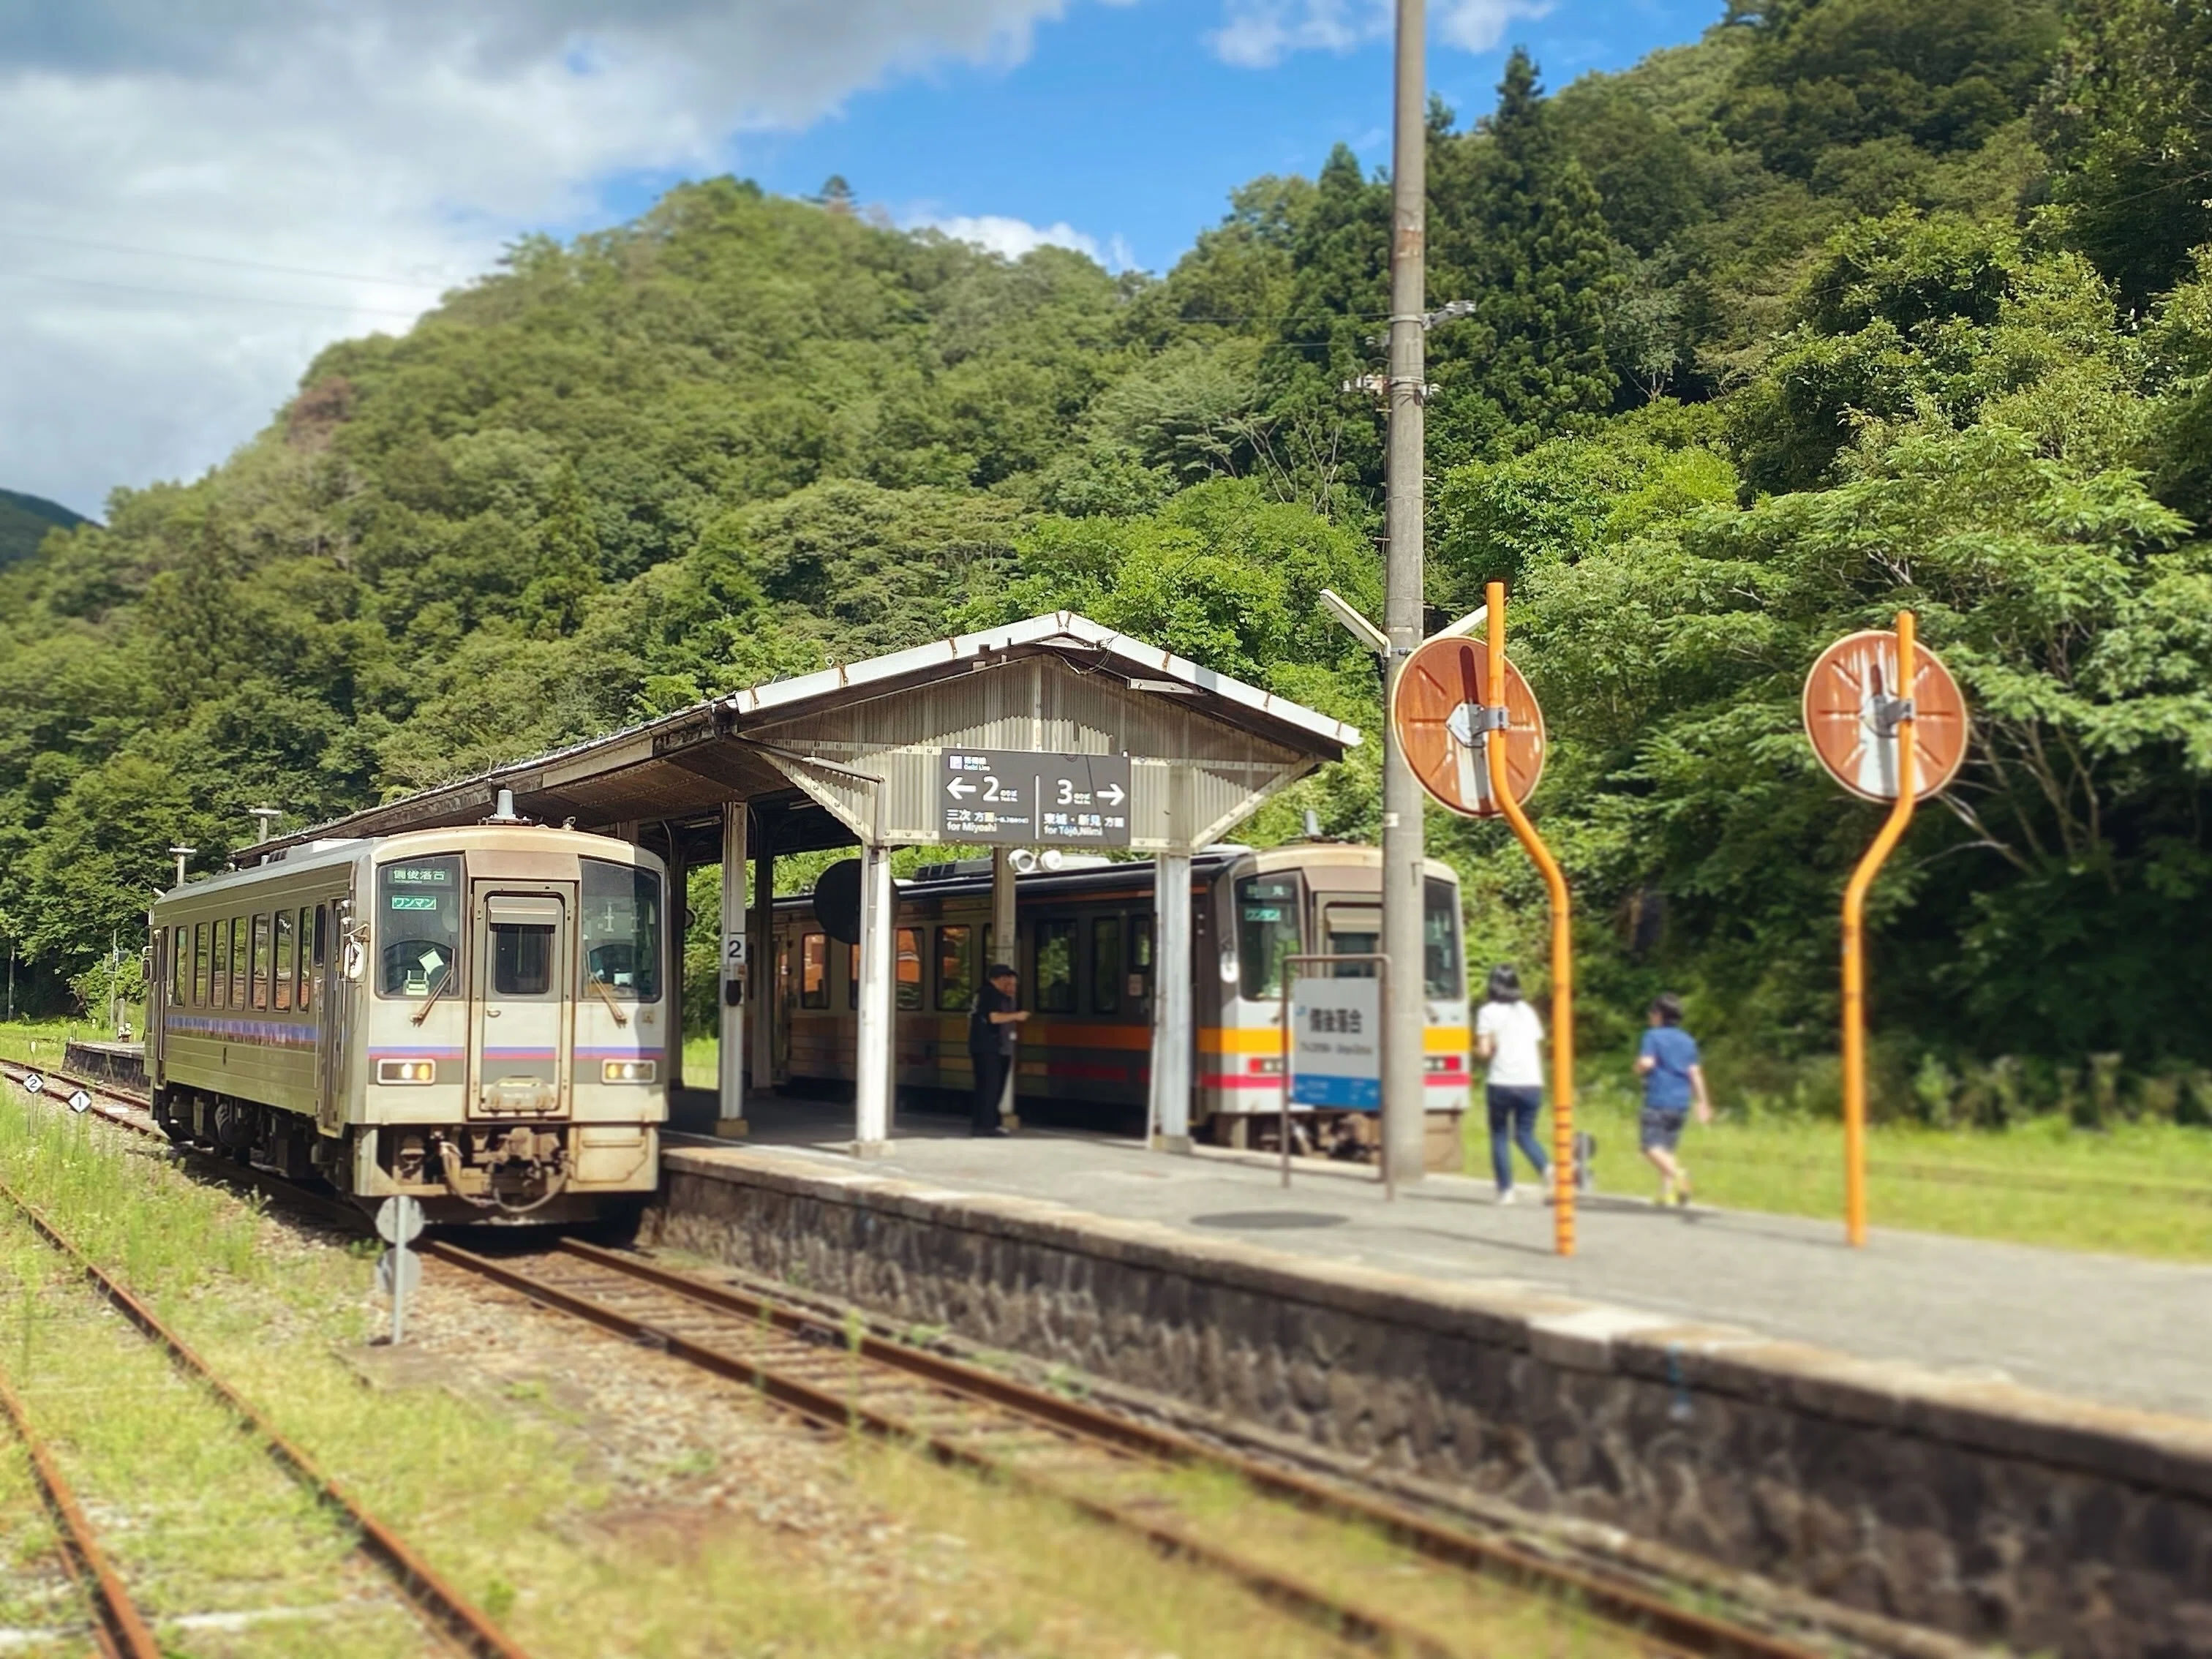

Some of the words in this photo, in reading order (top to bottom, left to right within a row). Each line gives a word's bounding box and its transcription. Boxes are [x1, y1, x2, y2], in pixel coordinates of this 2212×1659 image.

[982, 775, 999, 802] 2
[1056, 779, 1072, 805] 3
[946, 808, 971, 821] 三次
[947, 821, 961, 831] for
[962, 822, 998, 834] Miyoshi
[1044, 824, 1058, 835] for
[393, 897, 435, 908] ワンマン
[729, 940, 742, 958] 2
[29, 1078, 37, 1088] 2
[77, 1096, 82, 1107] 1
